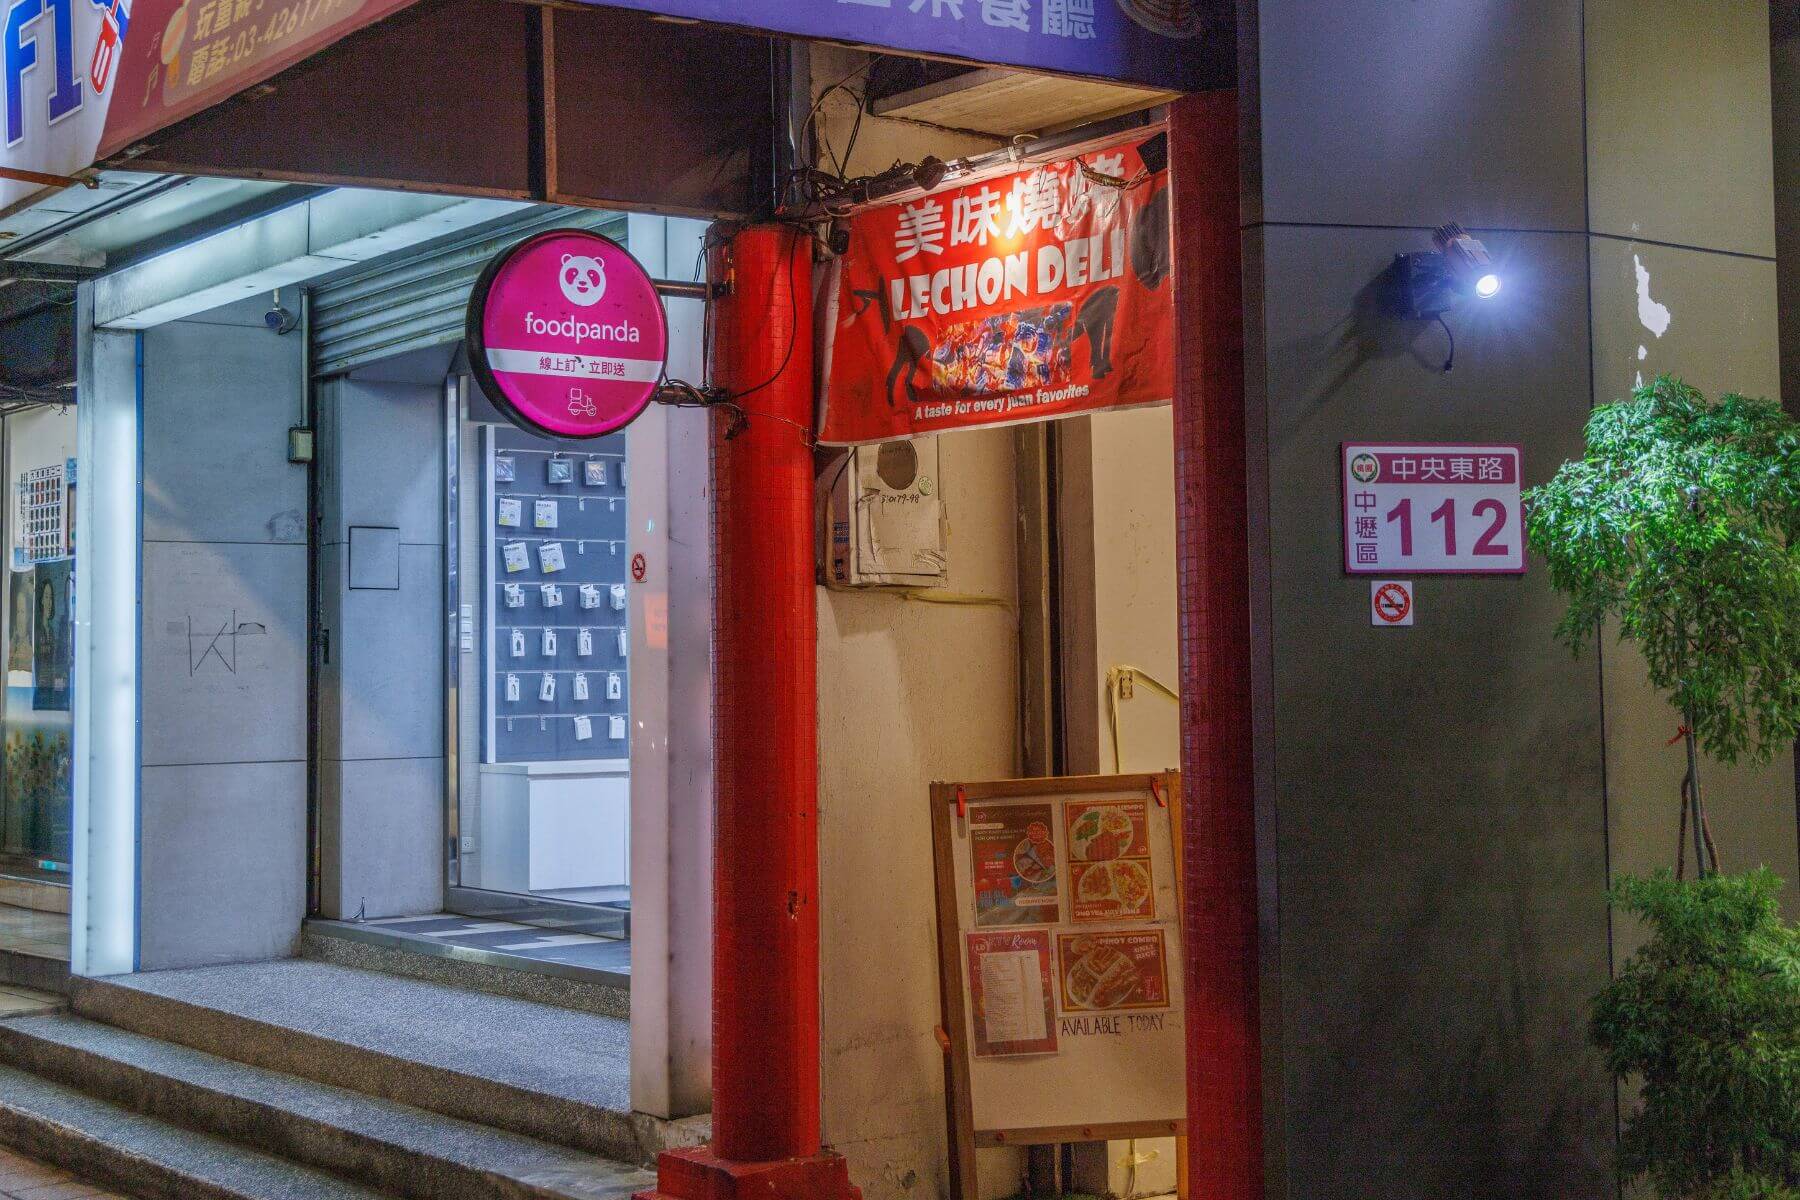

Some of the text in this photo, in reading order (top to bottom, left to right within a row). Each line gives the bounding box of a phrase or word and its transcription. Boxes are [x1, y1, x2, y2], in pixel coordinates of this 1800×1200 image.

[889, 228, 1126, 322] LECHON DELI
[524, 311, 640, 344] foodpanda
[915, 383, 1090, 420] A taste for every juan favorites
[1391, 457, 1504, 481] 中央東路
[1354, 490, 1379, 565] 中壢區
[1386, 497, 1509, 557] 112
[1061, 1014, 1164, 1037] AVAILABLE TODAY
